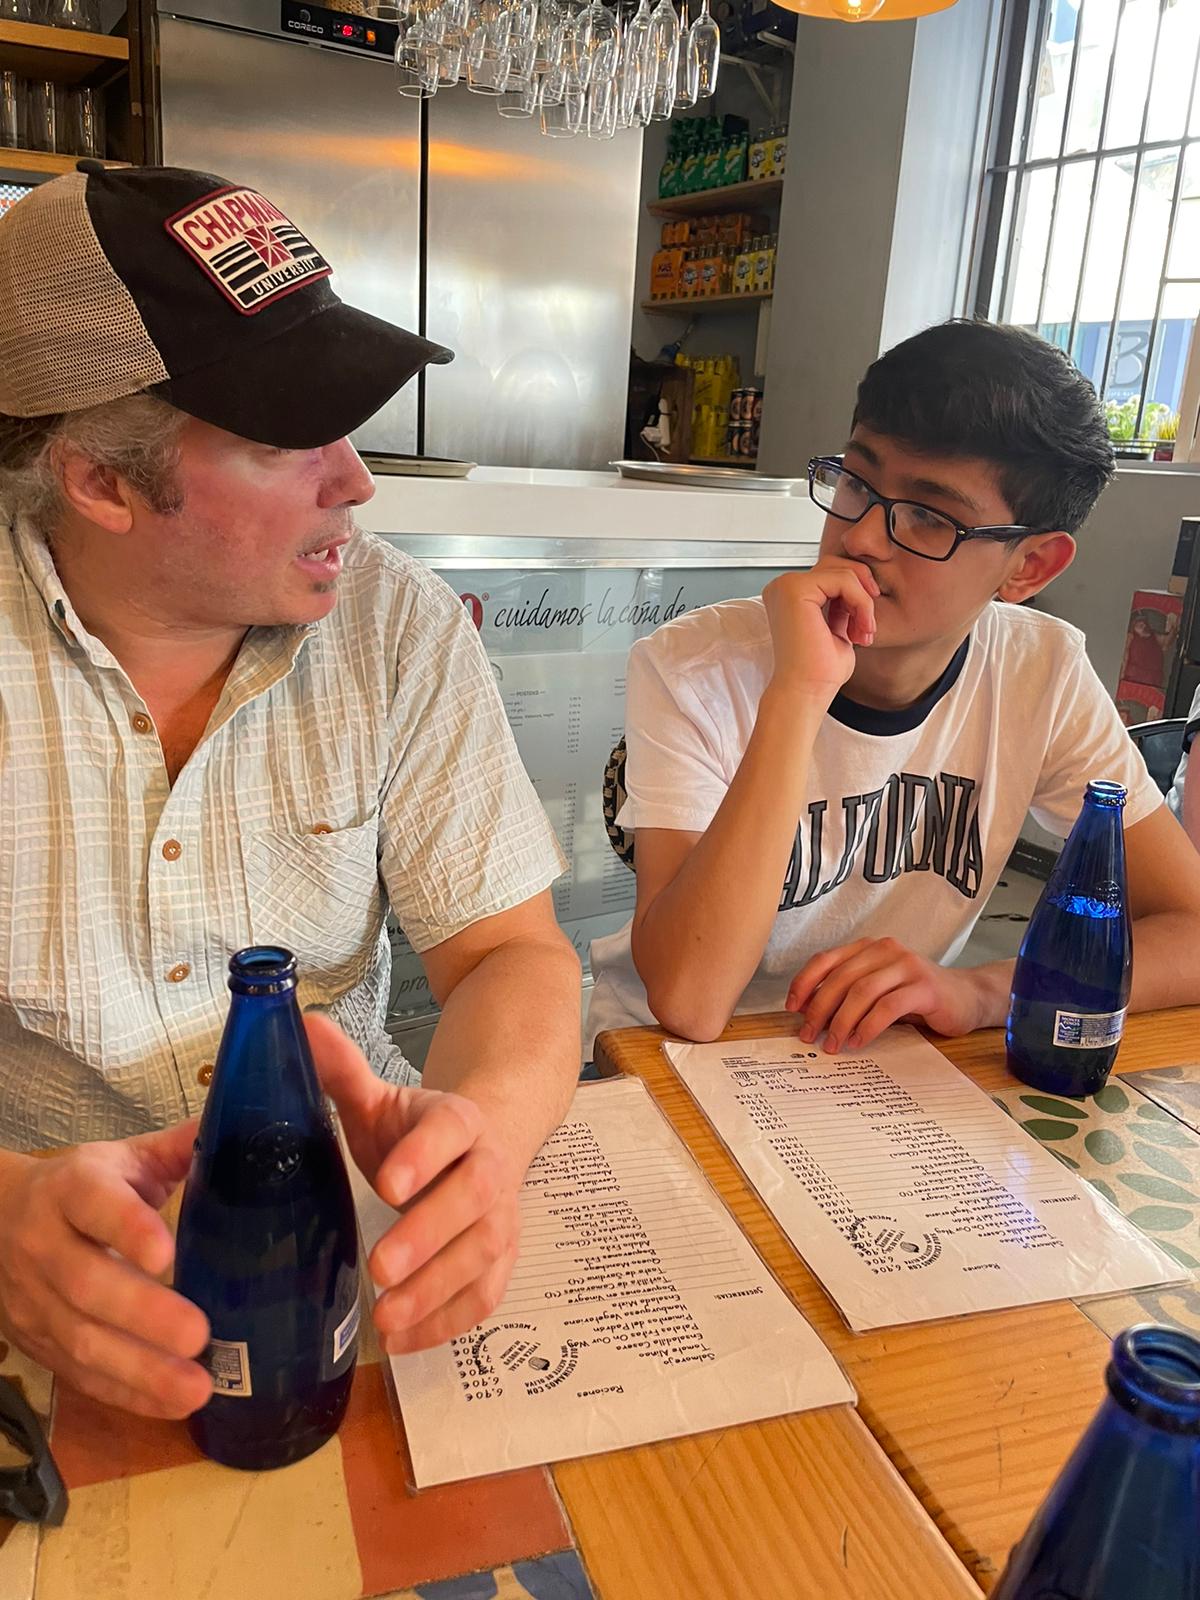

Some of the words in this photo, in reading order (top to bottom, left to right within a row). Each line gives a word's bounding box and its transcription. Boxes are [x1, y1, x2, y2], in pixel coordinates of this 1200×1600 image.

[287, 20, 324, 34] CORECO
[494, 588, 593, 628] cuidamos
[596, 587, 617, 626] la
[618, 600, 661, 626] caña
[583, 1260, 629, 1271] Manchego
[962, 1263, 1000, 1271] Raciones
[567, 1277, 584, 1285] (4)
[586, 1272, 622, 1281] Sardina
[544, 1290, 561, 1298] (4)
[563, 1282, 614, 1295] Camarones
[620, 1285, 676, 1295] Boquerones
[567, 1293, 605, 1303] Vinagre
[639, 1294, 680, 1306] Ensalada
[611, 1300, 637, 1309] Mixta
[623, 1304, 687, 1316] Hamburguesa
[563, 1310, 622, 1325] Vegetariana
[647, 1313, 692, 1325] Pimientos
[592, 1322, 629, 1333] Padrón
[630, 1320, 644, 1328] del
[660, 1322, 698, 1333] Patatas
[630, 1328, 659, 1338] Fritas
[566, 1338, 589, 1350] Way
[652, 1332, 703, 1346] Ensaladilla
[615, 1341, 650, 1350] Casera
[671, 1343, 709, 1354] Tomate
[663, 1352, 714, 1364] Salmorejo
[524, 1378, 545, 1387] OLIVA
[526, 1386, 544, 1395] CON
[576, 1385, 623, 1397] Raciones
